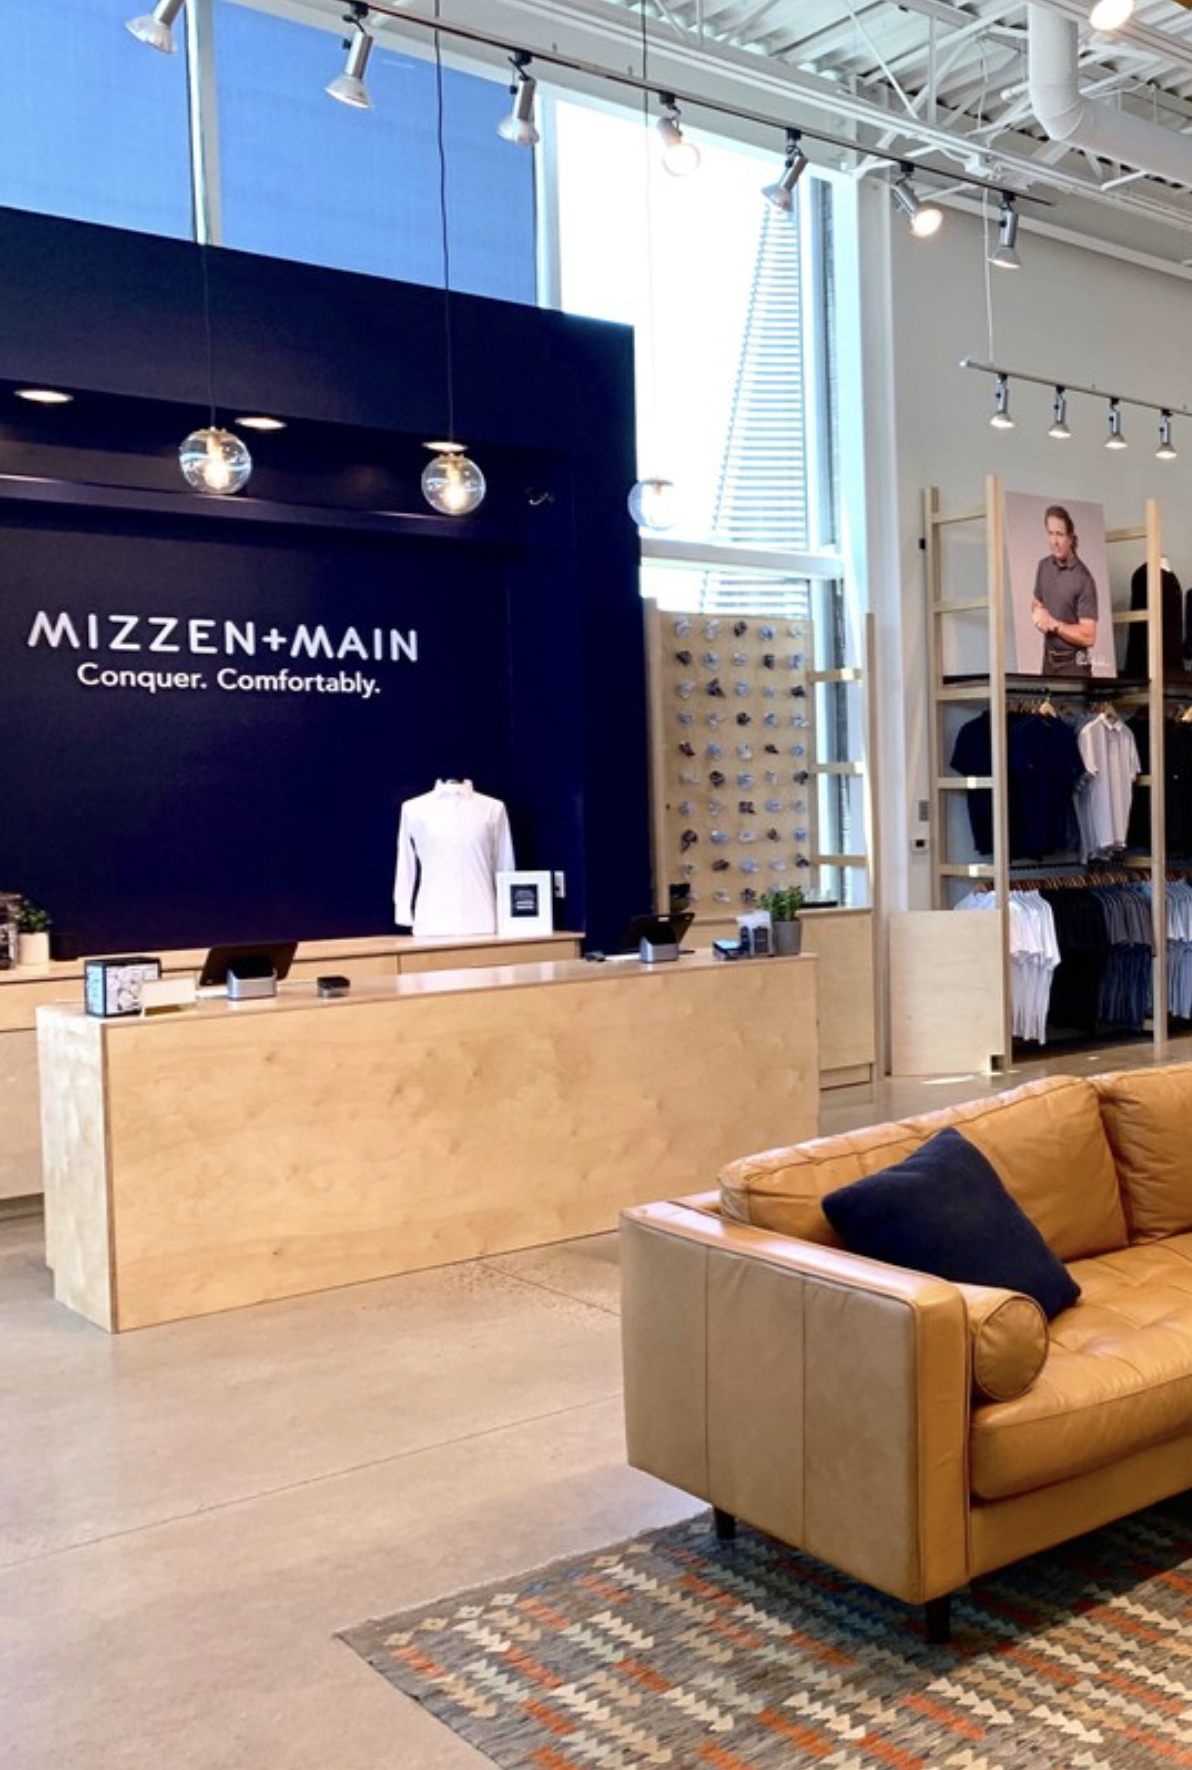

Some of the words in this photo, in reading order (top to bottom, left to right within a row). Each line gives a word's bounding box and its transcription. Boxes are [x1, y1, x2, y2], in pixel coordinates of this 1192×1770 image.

[27, 610, 419, 663] MIZZEN+MAIN
[77, 662, 207, 693] Conquer.
[217, 668, 381, 698] Comfortably.
